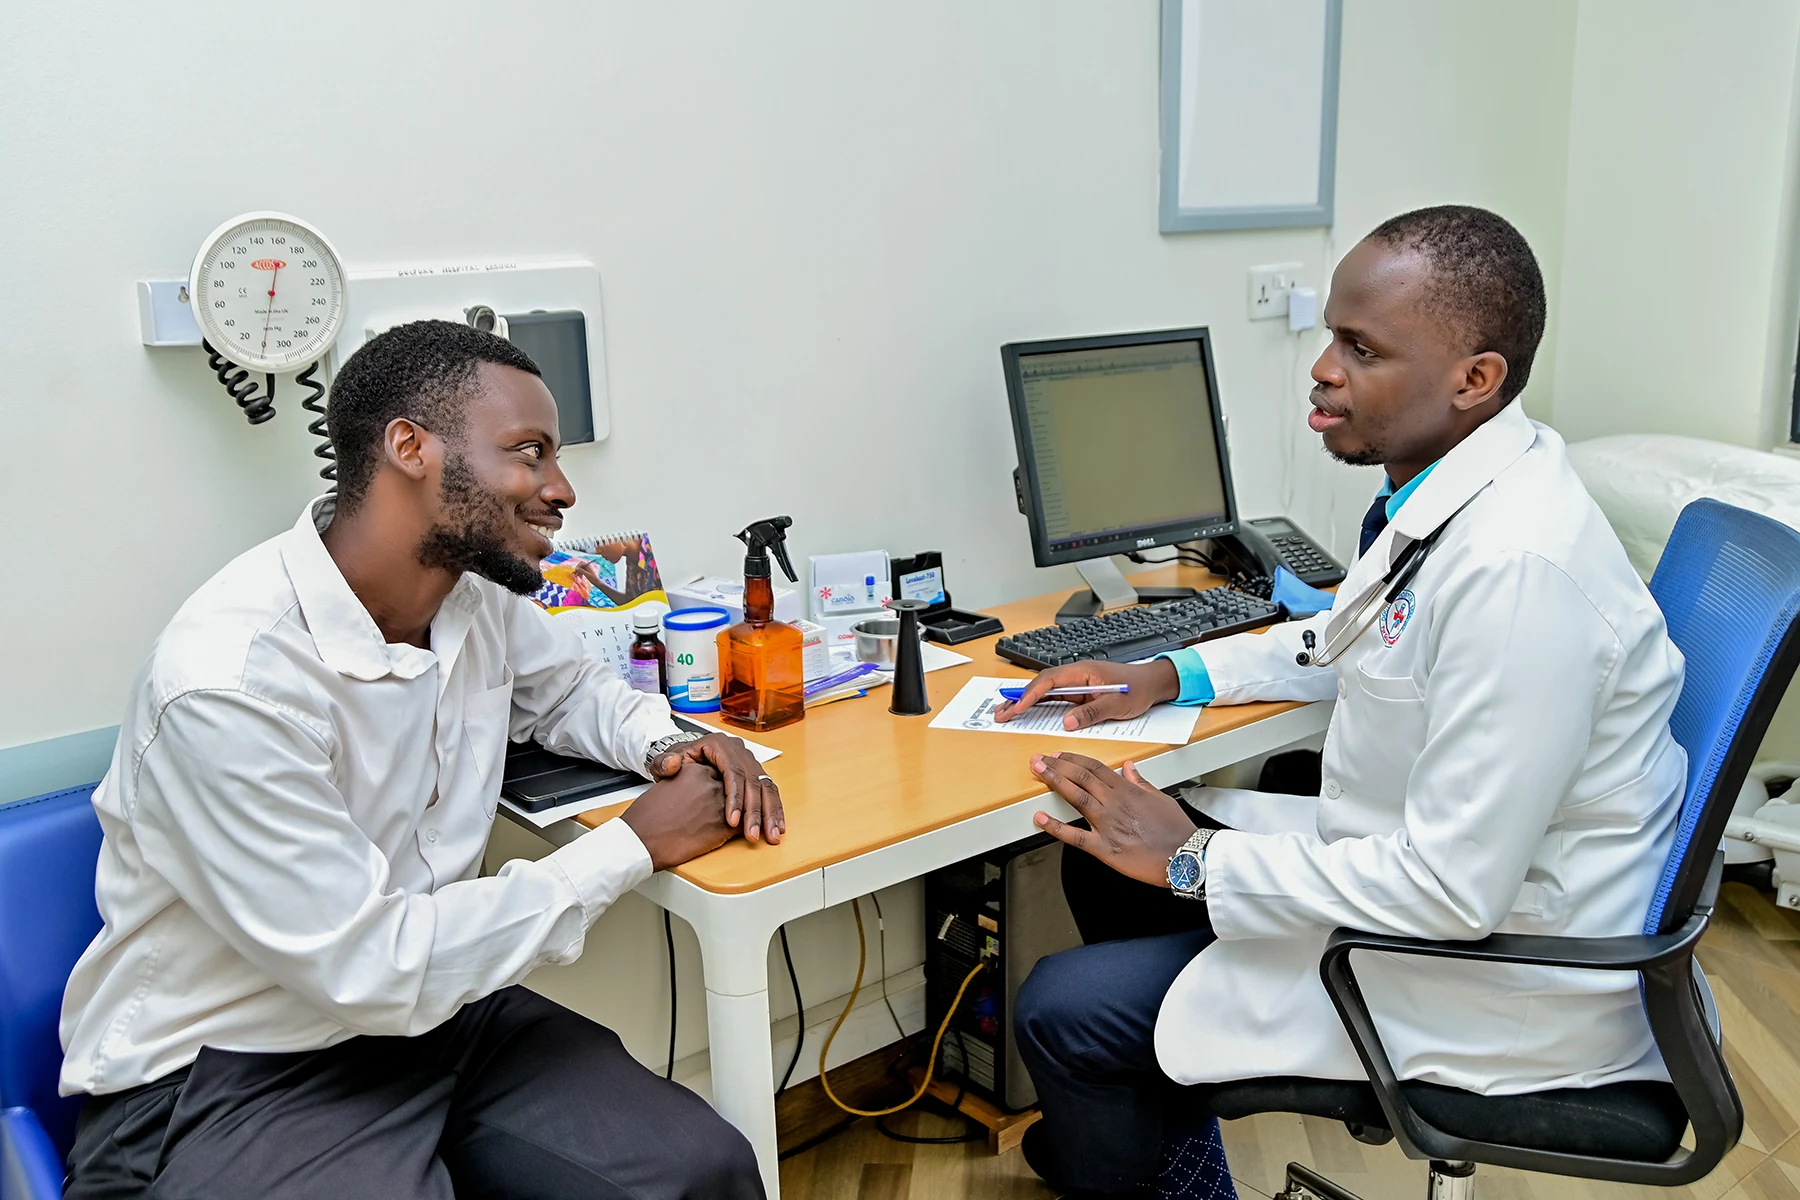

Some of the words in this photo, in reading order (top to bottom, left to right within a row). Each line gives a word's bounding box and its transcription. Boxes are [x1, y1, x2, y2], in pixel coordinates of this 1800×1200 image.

[249, 237, 264, 245] 140
[271, 237, 286, 245] 160
[232, 247, 247, 255] 120
[220, 261, 235, 269] 100
[302, 260, 317, 268] 200
[213, 280, 224, 288] 80
[310, 278, 325, 286] 220
[214, 301, 225, 309] 60
[224, 319, 235, 327] 40
[305, 317, 320, 325] 260
[239, 333, 250, 341] 20
[261, 341, 267, 349] 0
[1136, 537, 1156, 548] DELL
[581, 631, 587, 639] T
[594, 628, 604, 637] W
[610, 626, 616, 634] T
[624, 623, 630, 631] F
[616, 644, 621, 652] 8
[603, 656, 610, 664] 14
[676, 652, 694, 666] 40
